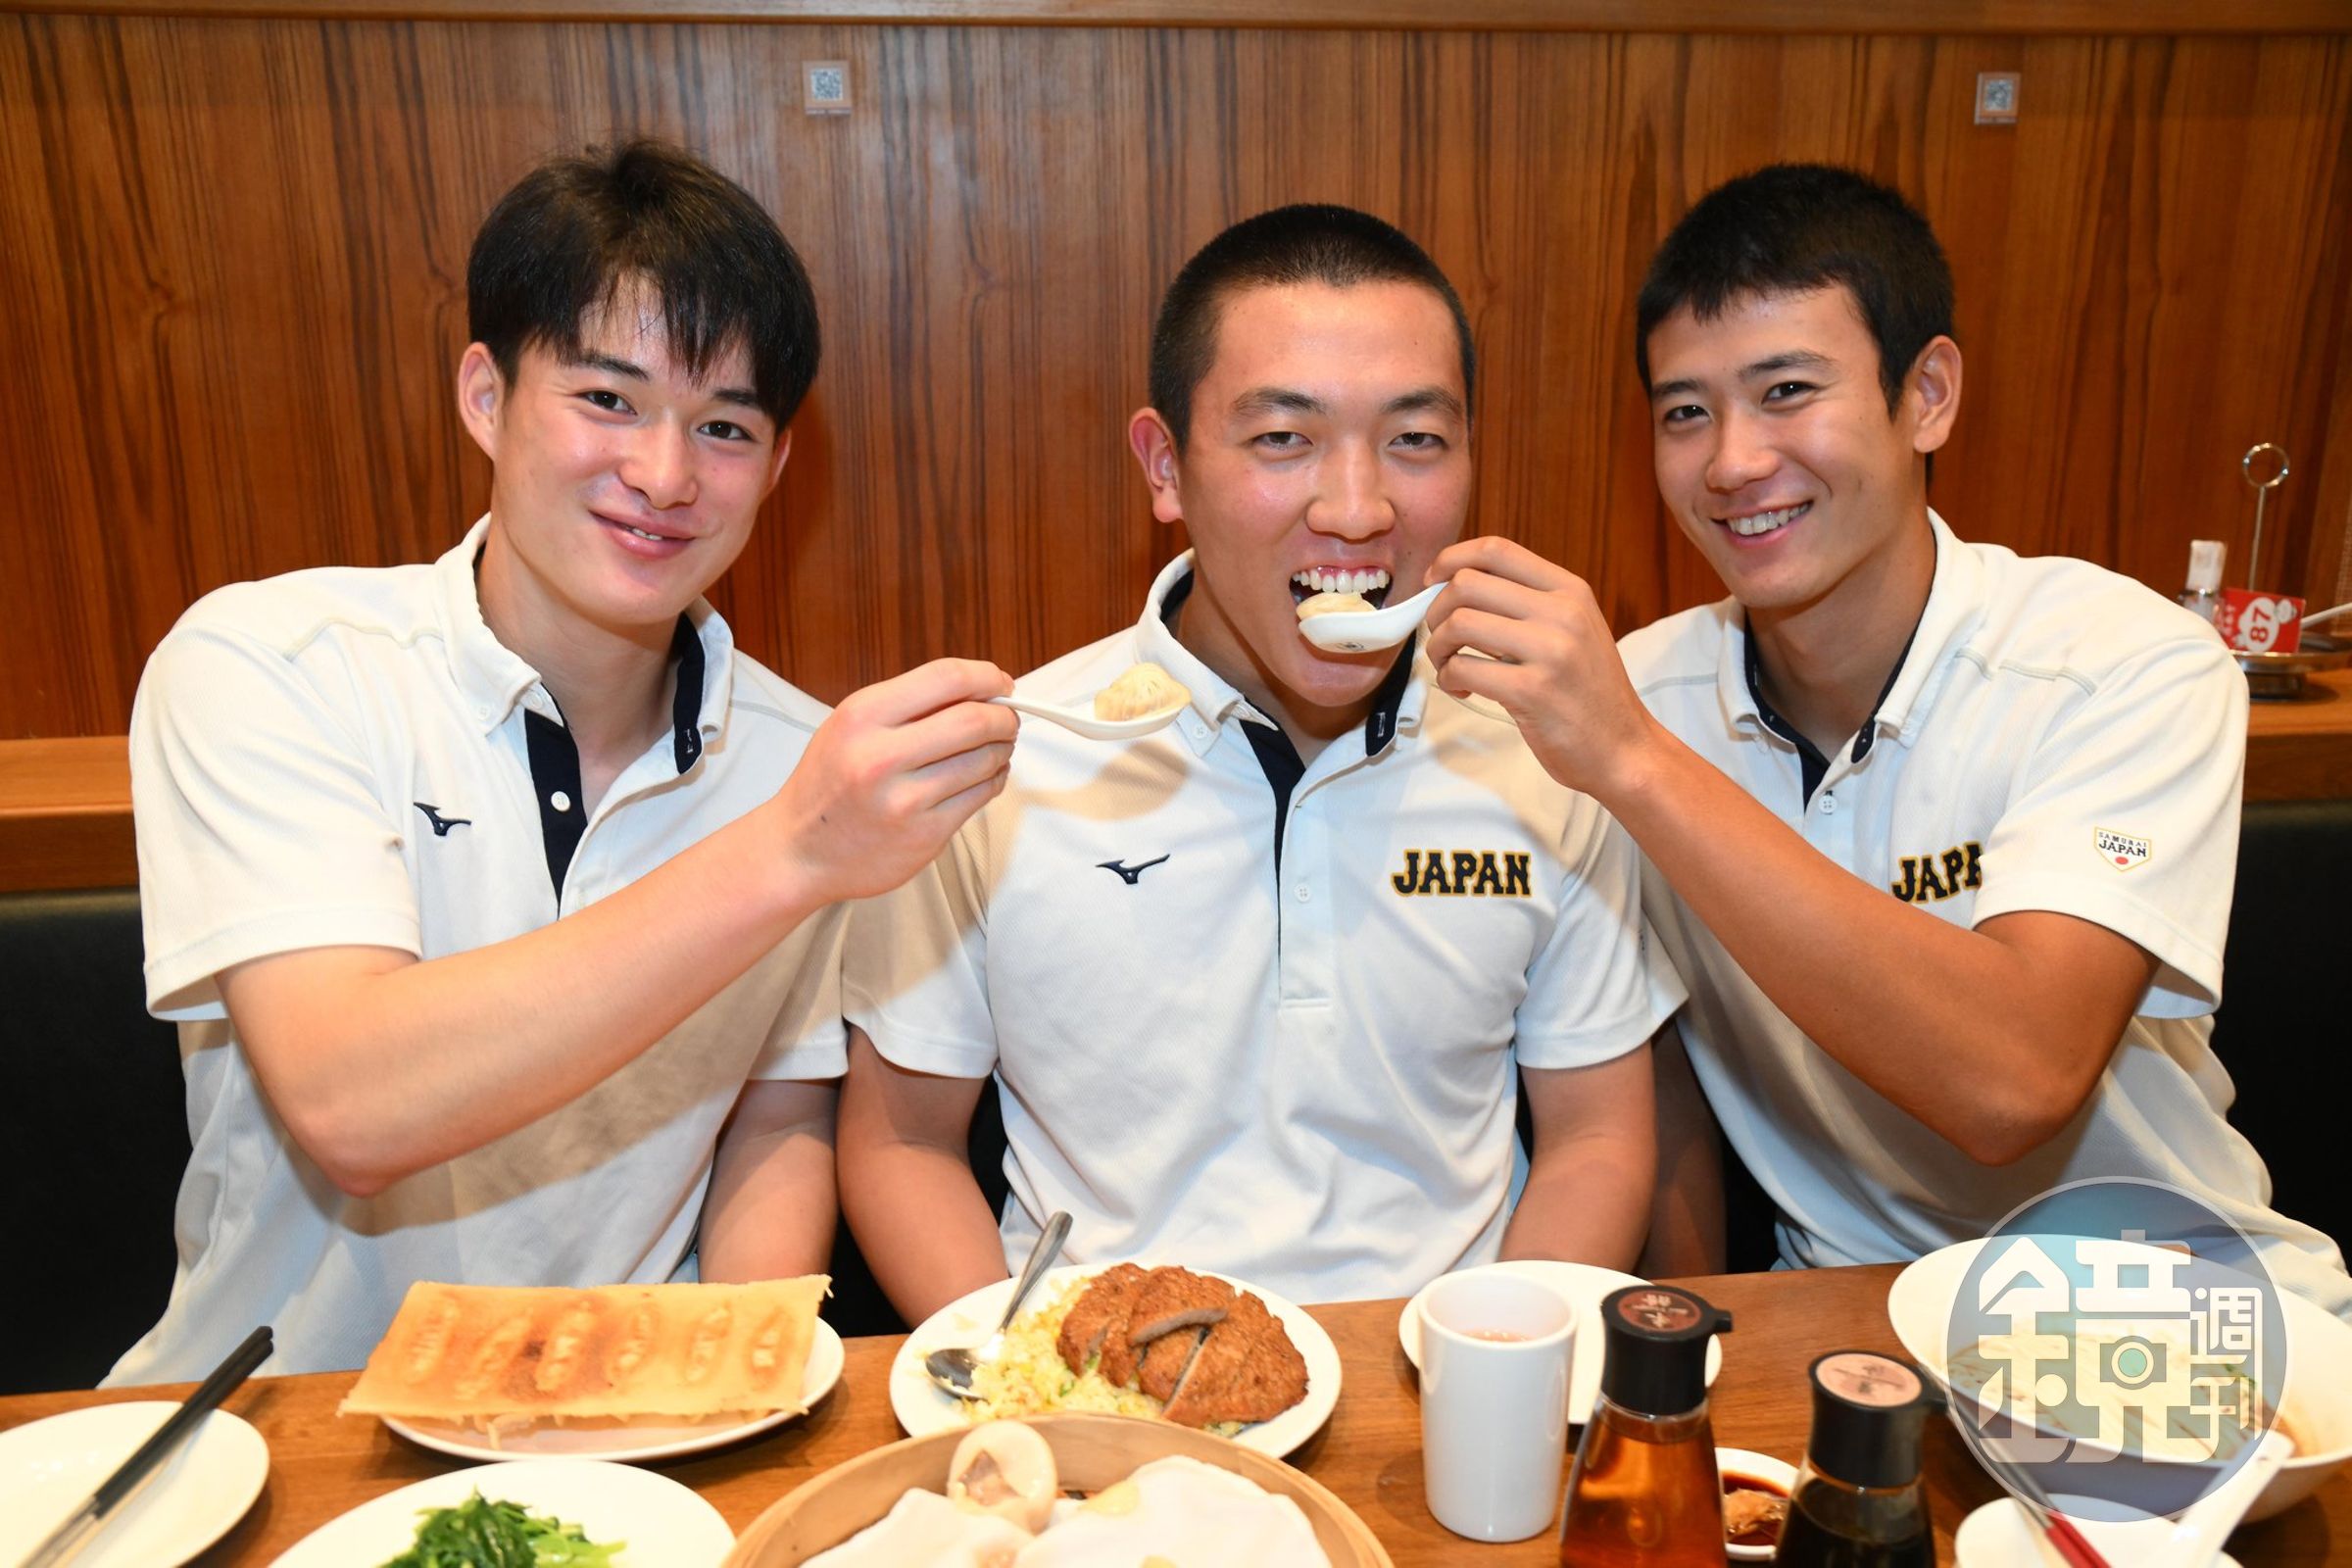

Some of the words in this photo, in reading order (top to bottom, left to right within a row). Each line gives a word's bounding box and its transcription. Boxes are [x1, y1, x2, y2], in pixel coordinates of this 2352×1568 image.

[2250, 608, 2271, 643] 87
[2098, 840, 2147, 858] JAPAN
[1391, 849, 1532, 898] JAPAN
[1891, 841, 1984, 904] JAPA
